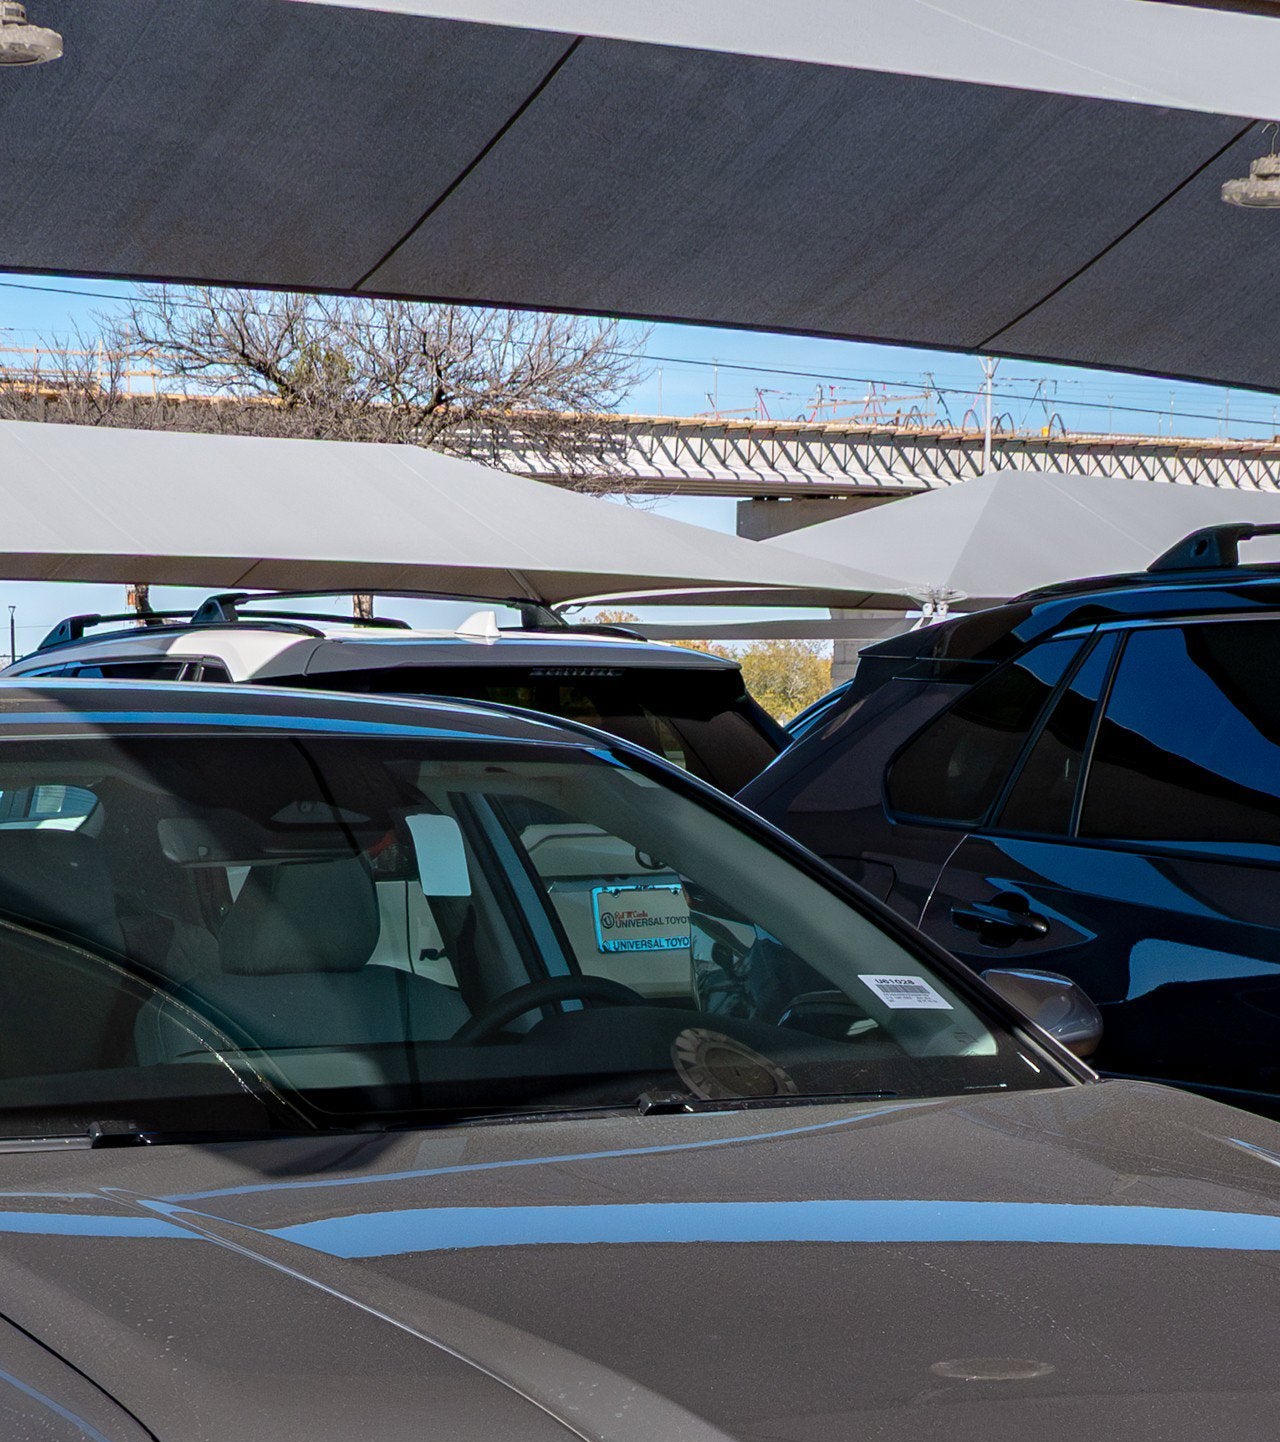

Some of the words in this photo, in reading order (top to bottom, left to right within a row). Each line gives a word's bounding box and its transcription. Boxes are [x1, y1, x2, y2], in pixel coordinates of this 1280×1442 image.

[615, 917, 664, 929] UNIVERSAL
[613, 938, 664, 950] UNIVERSAL
[665, 936, 690, 947] TOYO
